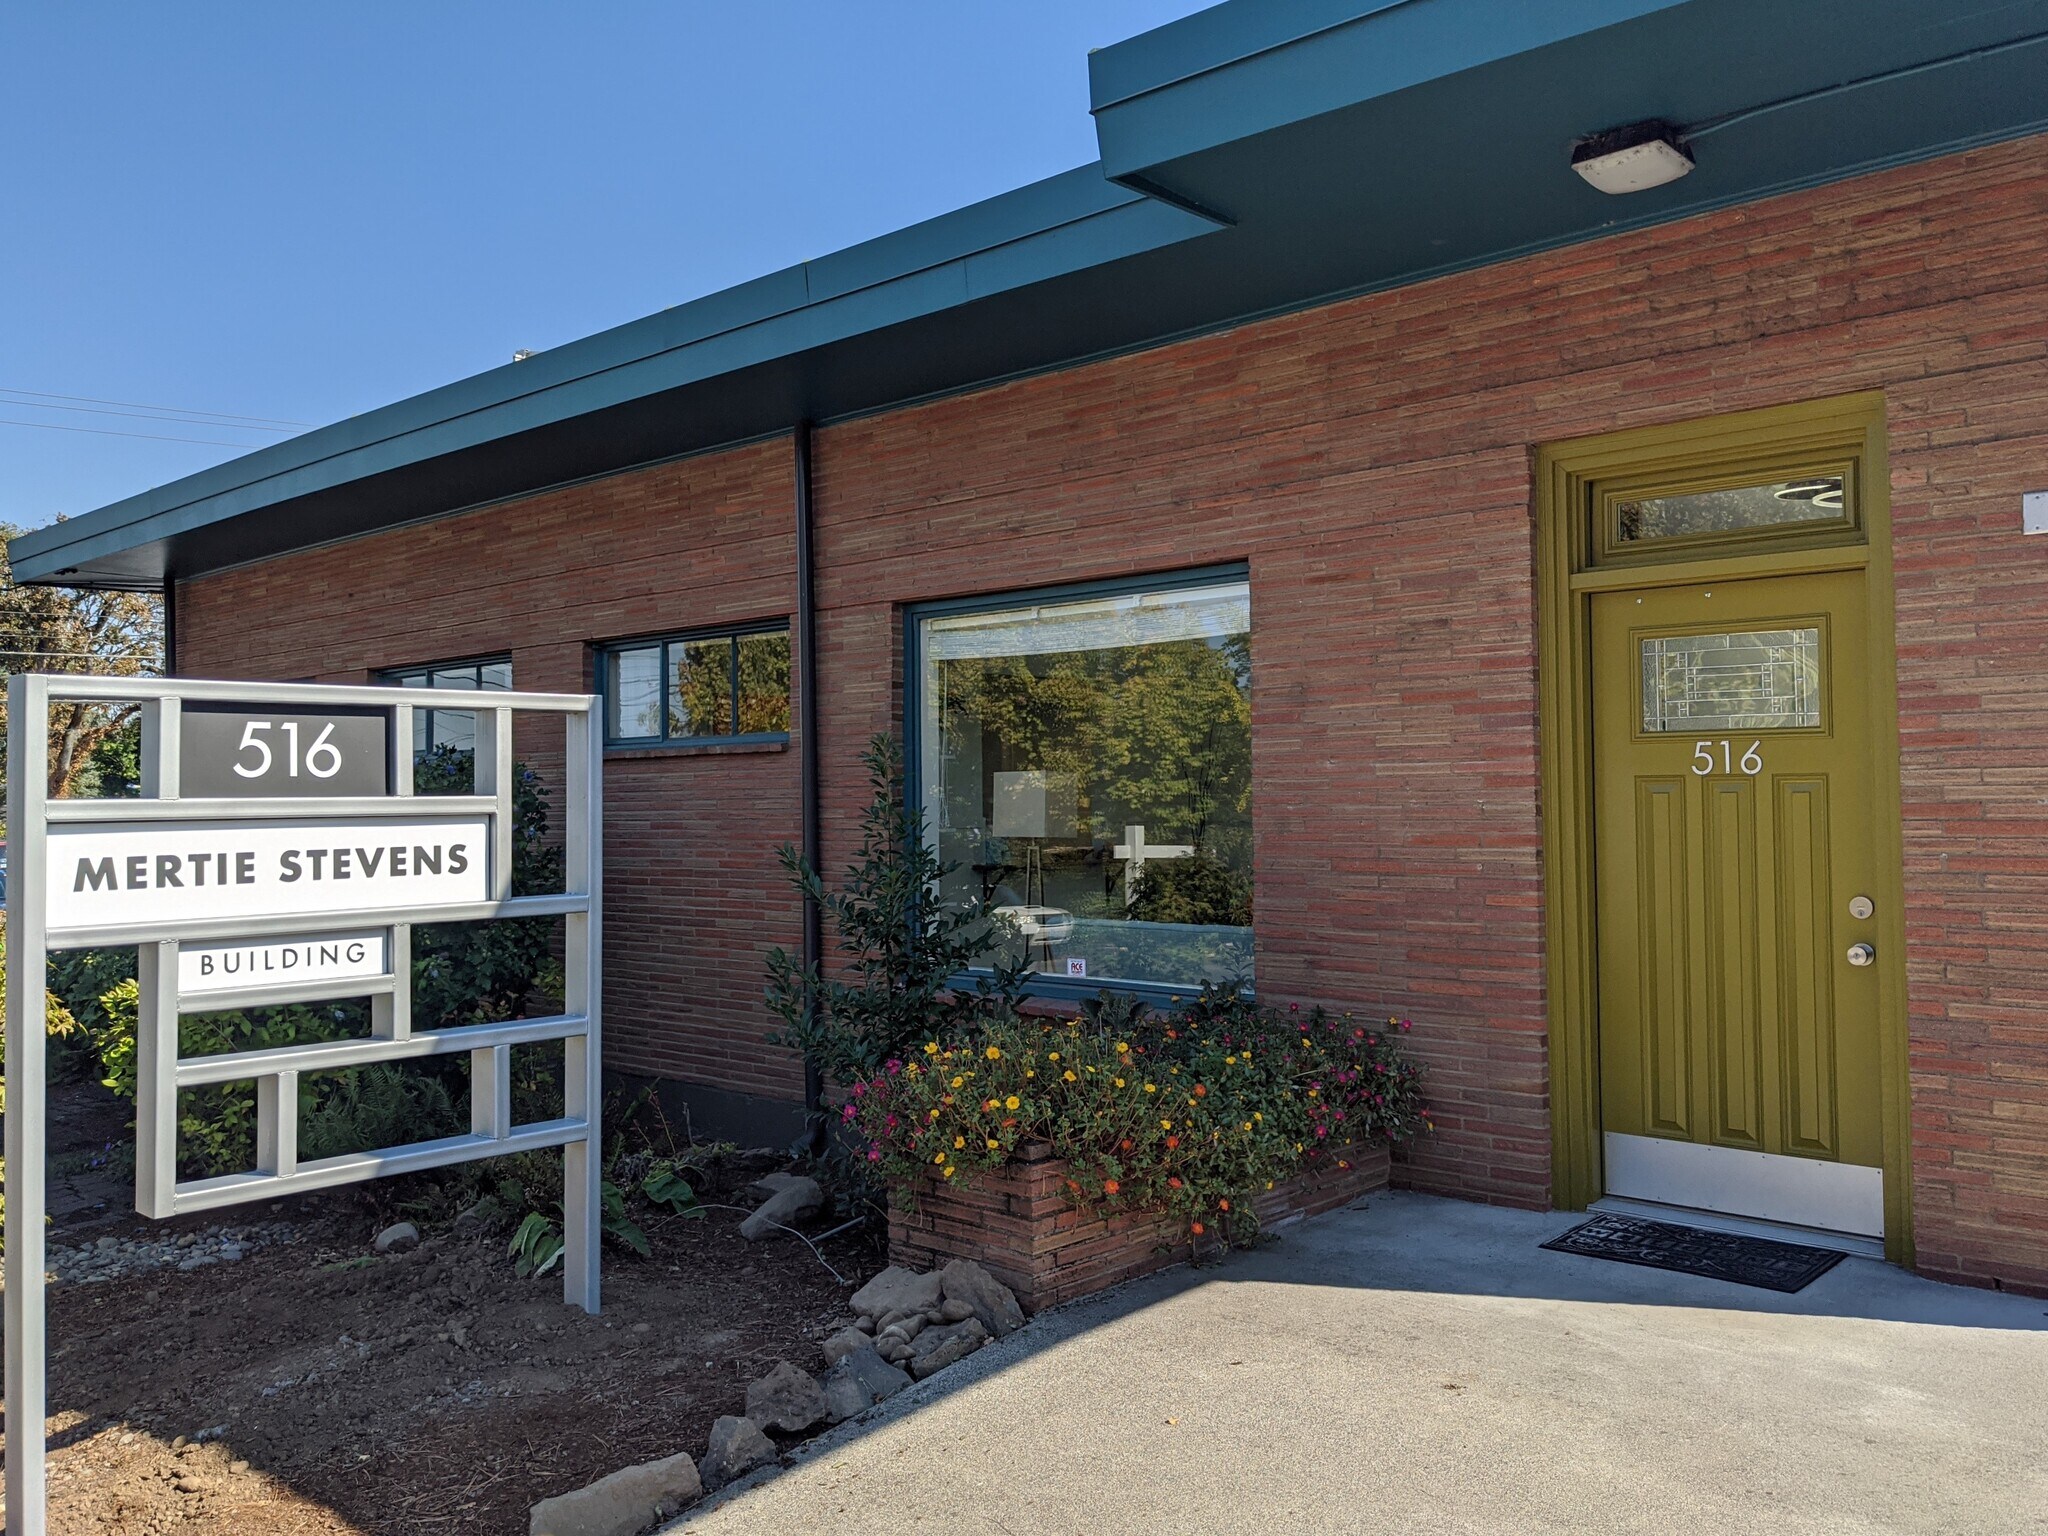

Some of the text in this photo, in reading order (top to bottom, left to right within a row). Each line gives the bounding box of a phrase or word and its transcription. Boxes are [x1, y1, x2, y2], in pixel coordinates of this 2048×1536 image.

[233, 722, 342, 778] 516
[1691, 740, 1763, 775] 516
[73, 843, 468, 892] MERTIE STEVENS
[200, 942, 365, 976] BUILDING
[1071, 962, 1083, 971] ACE
